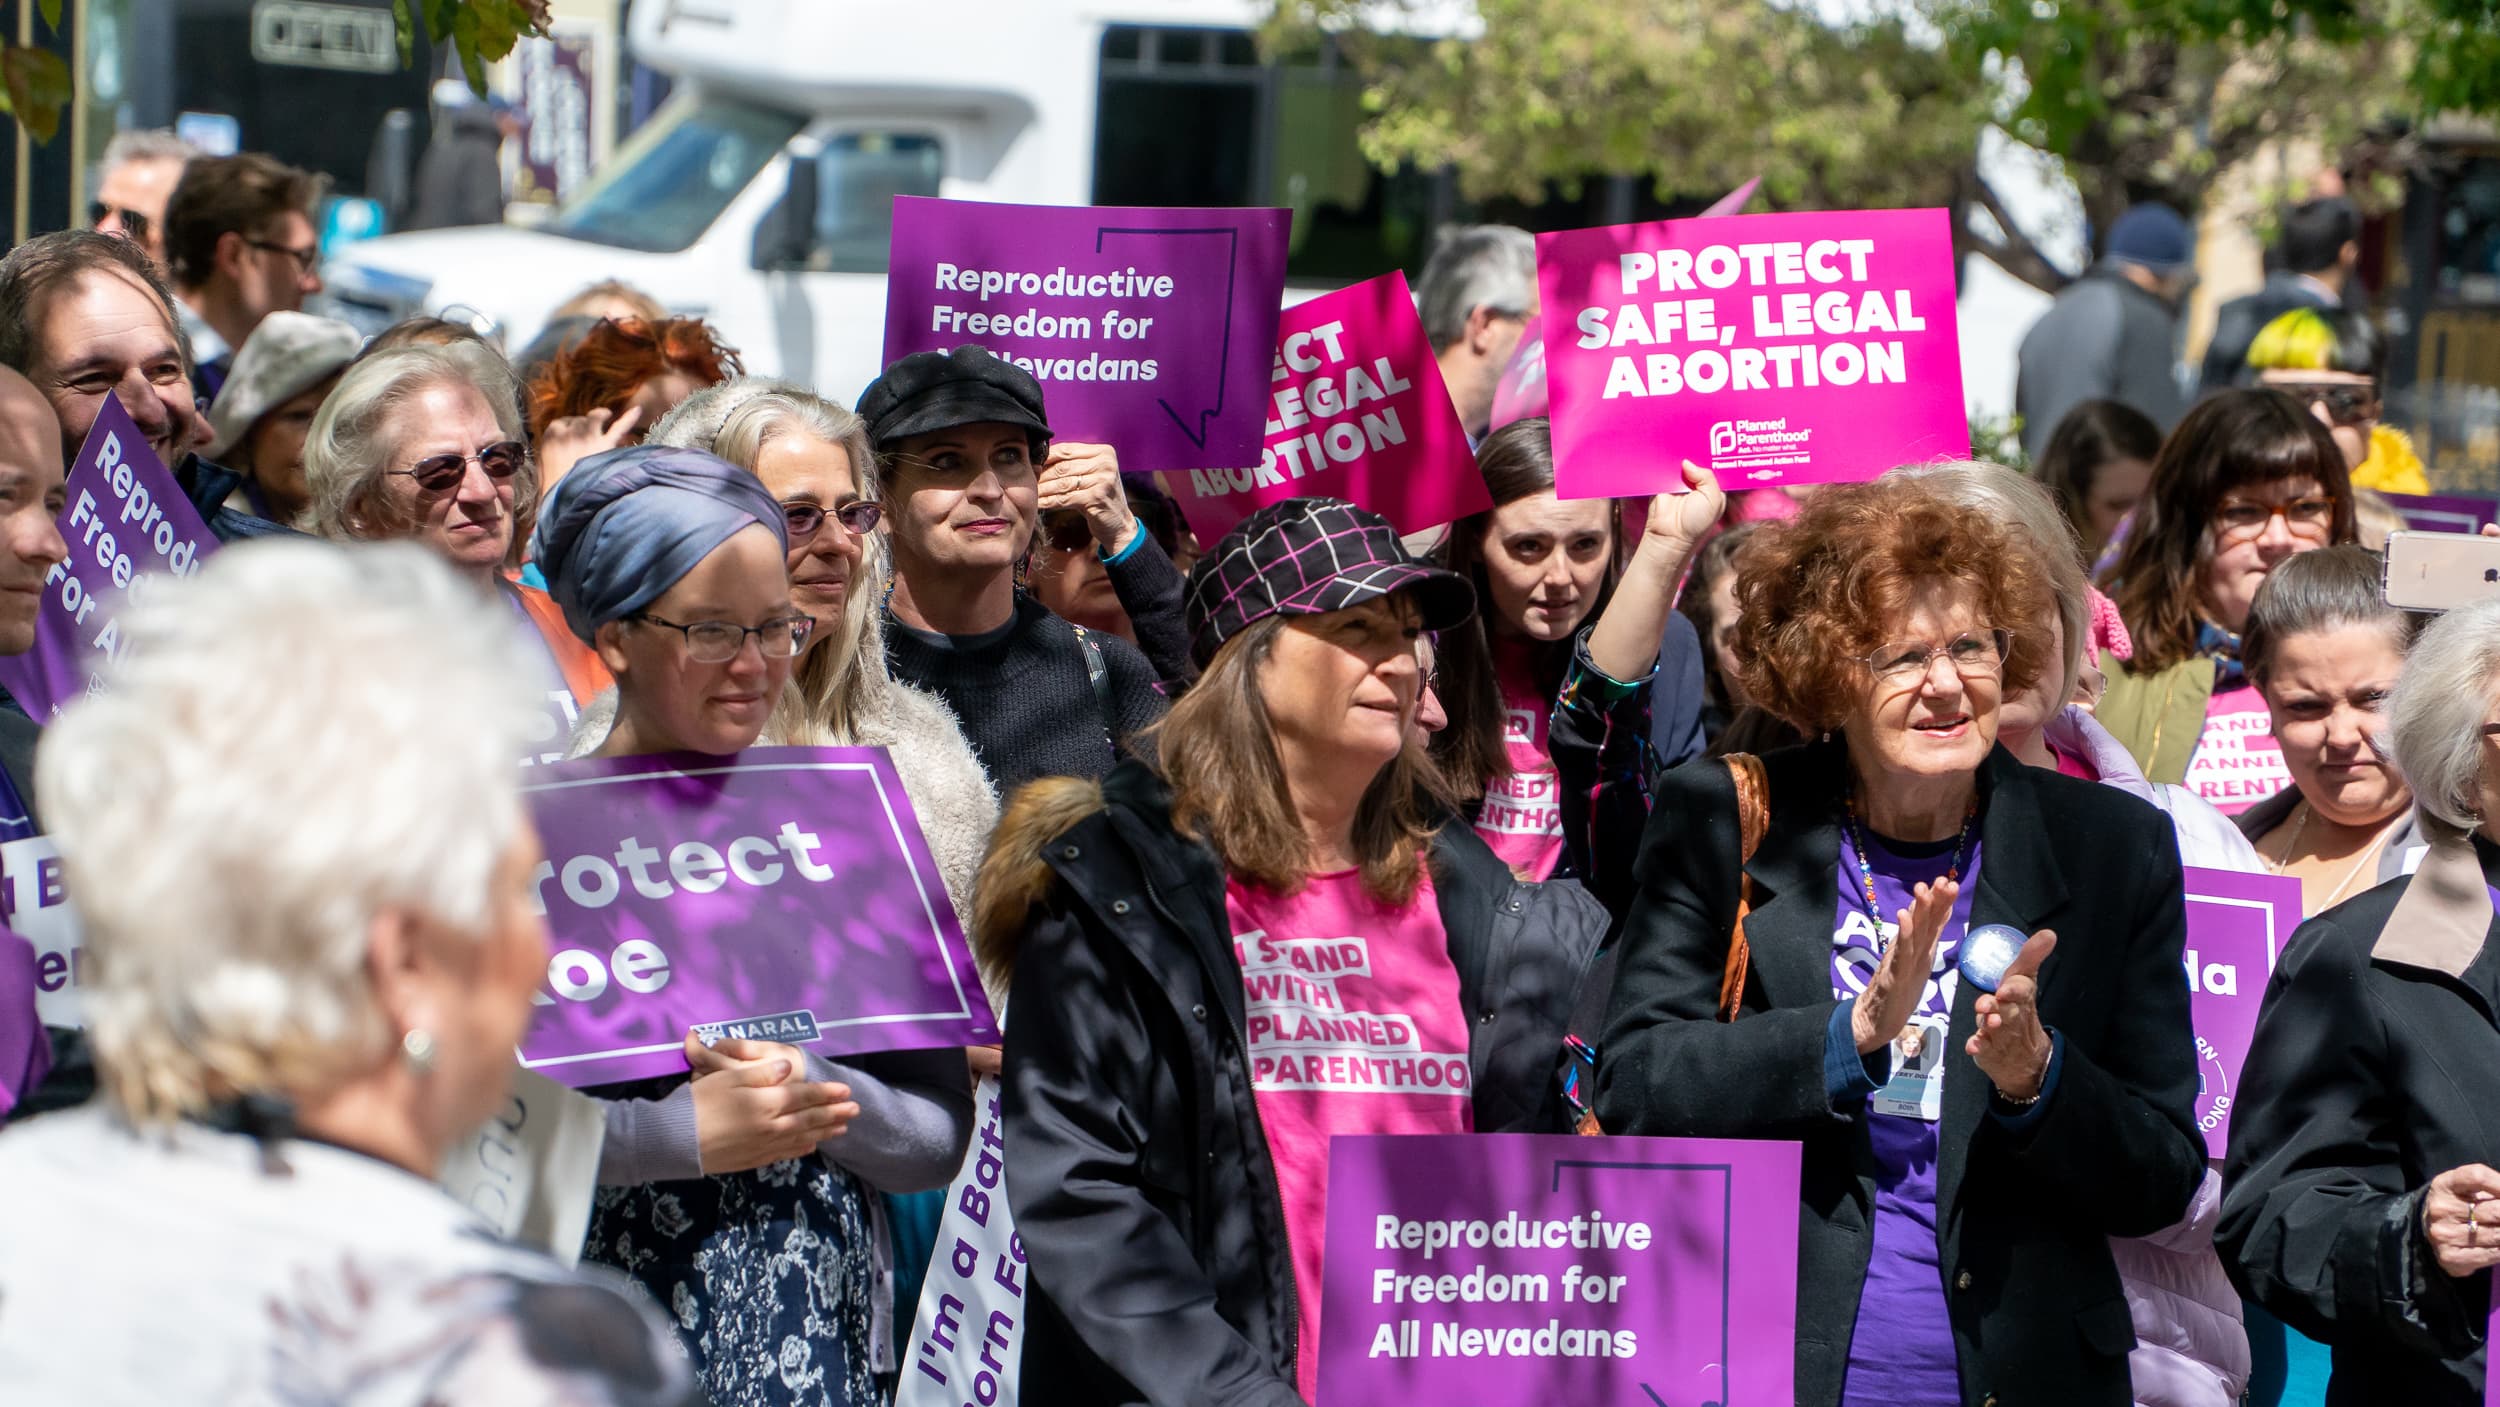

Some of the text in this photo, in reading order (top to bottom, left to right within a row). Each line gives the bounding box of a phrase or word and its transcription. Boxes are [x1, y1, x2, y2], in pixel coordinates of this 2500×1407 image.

[262, 8, 392, 57] OPEN
[936, 262, 1174, 301] Reproductive
[1620, 239, 1875, 294] PROTECT
[932, 305, 1153, 340] Freedom for
[1576, 290, 1925, 349] SAFE, LEGAL
[1602, 341, 1906, 399] ABORTION
[1736, 417, 1786, 432] Planned
[1737, 430, 1810, 445] Parenthood
[532, 821, 835, 917] rotect
[1257, 935, 1365, 974] SAND
[1245, 974, 1335, 1009] WITH
[728, 1016, 809, 1040] NARAL
[1248, 1014, 1411, 1045] PLANNED
[1254, 1055, 1470, 1089] PARENTHOO
[1375, 1210, 1652, 1260] Reproductive
[1372, 1265, 1627, 1304] Freedom for
[917, 1293, 965, 1387] I'm
[952, 1237, 979, 1279] a
[1368, 1318, 1638, 1359] All Nevadans
[963, 1310, 1014, 1407] orn
